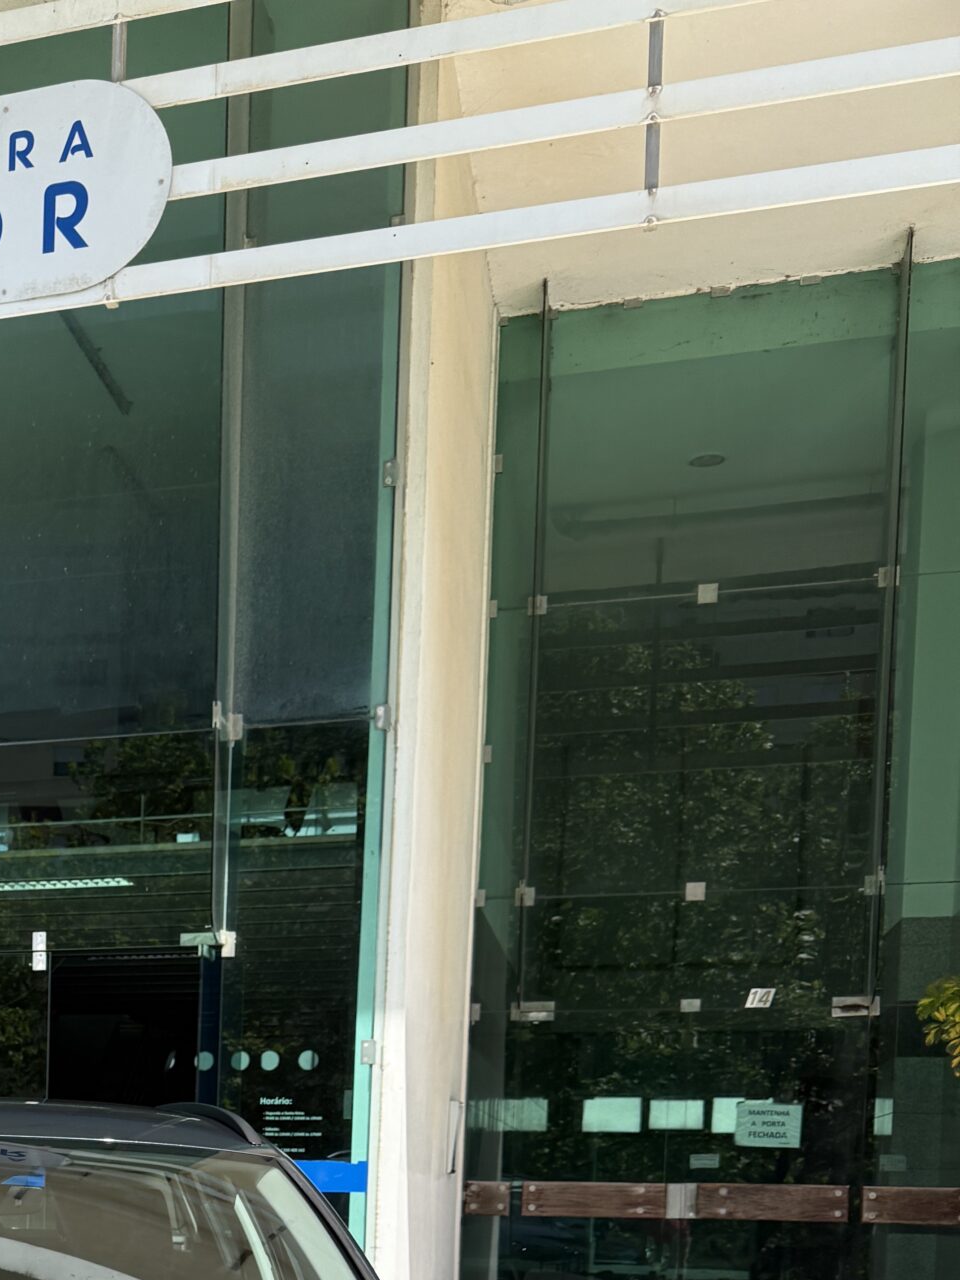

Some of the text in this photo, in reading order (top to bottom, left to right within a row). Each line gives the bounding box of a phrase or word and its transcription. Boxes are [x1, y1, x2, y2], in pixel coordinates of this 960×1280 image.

[749, 990, 772, 1006] 14
[747, 1109, 790, 1117] MANTENHA
[761, 1120, 786, 1128] PORTA
[747, 1130, 788, 1139] FECHADA
